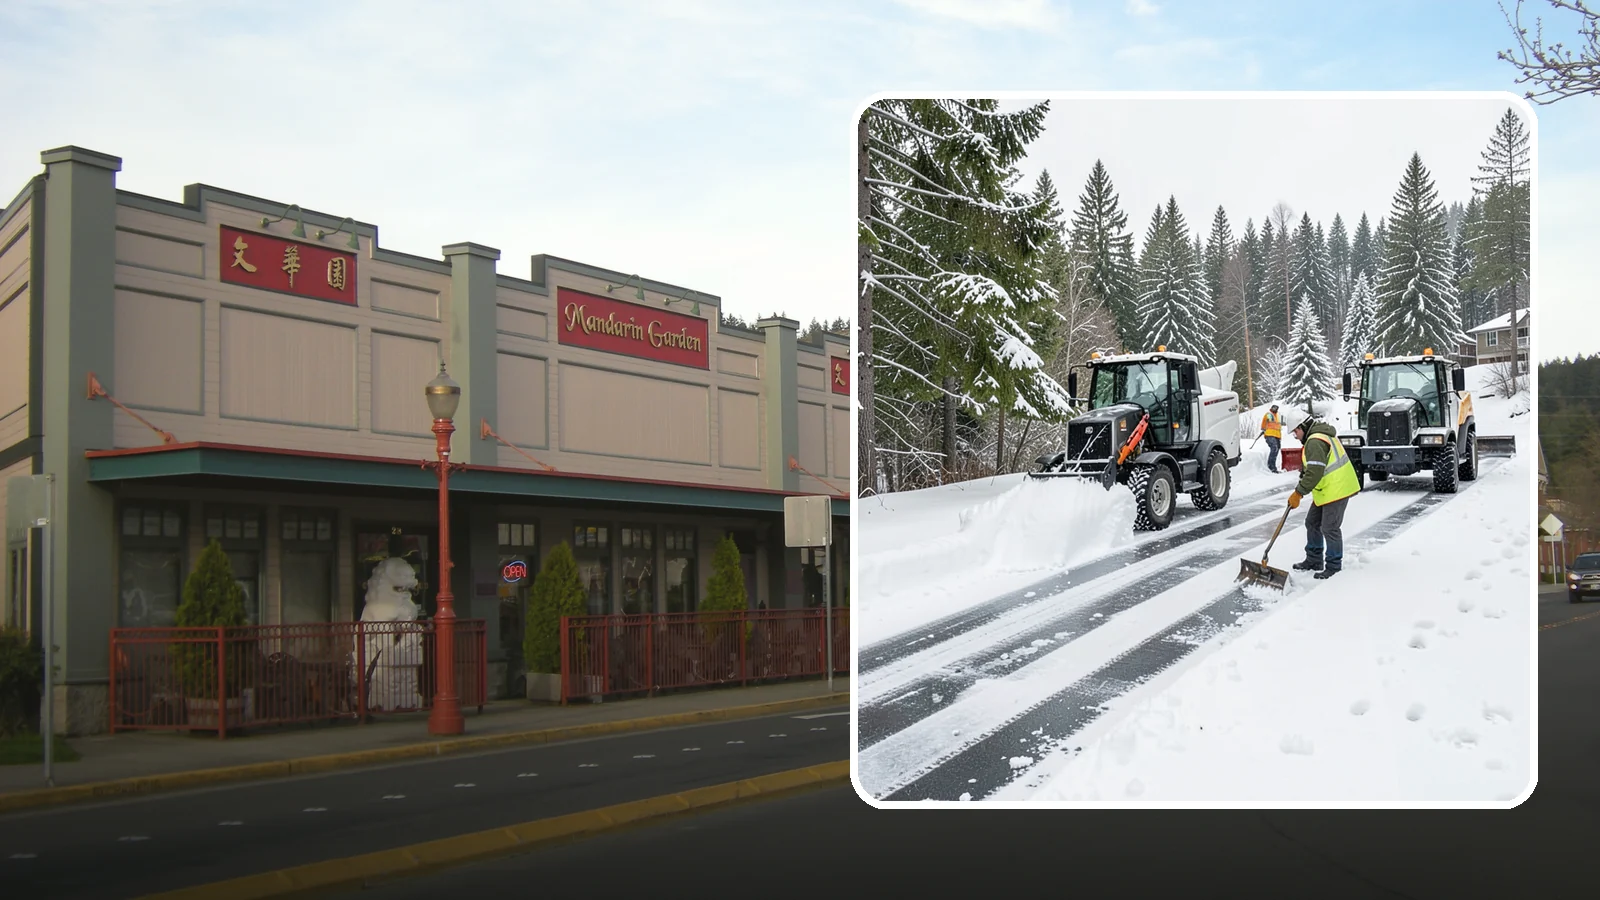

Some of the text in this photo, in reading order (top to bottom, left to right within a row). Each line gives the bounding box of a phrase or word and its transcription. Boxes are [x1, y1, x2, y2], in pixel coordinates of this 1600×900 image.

[565, 302, 701, 352] Mandarin Garden
[834, 363, 846, 386] 文
[503, 565, 527, 578] OPEN
